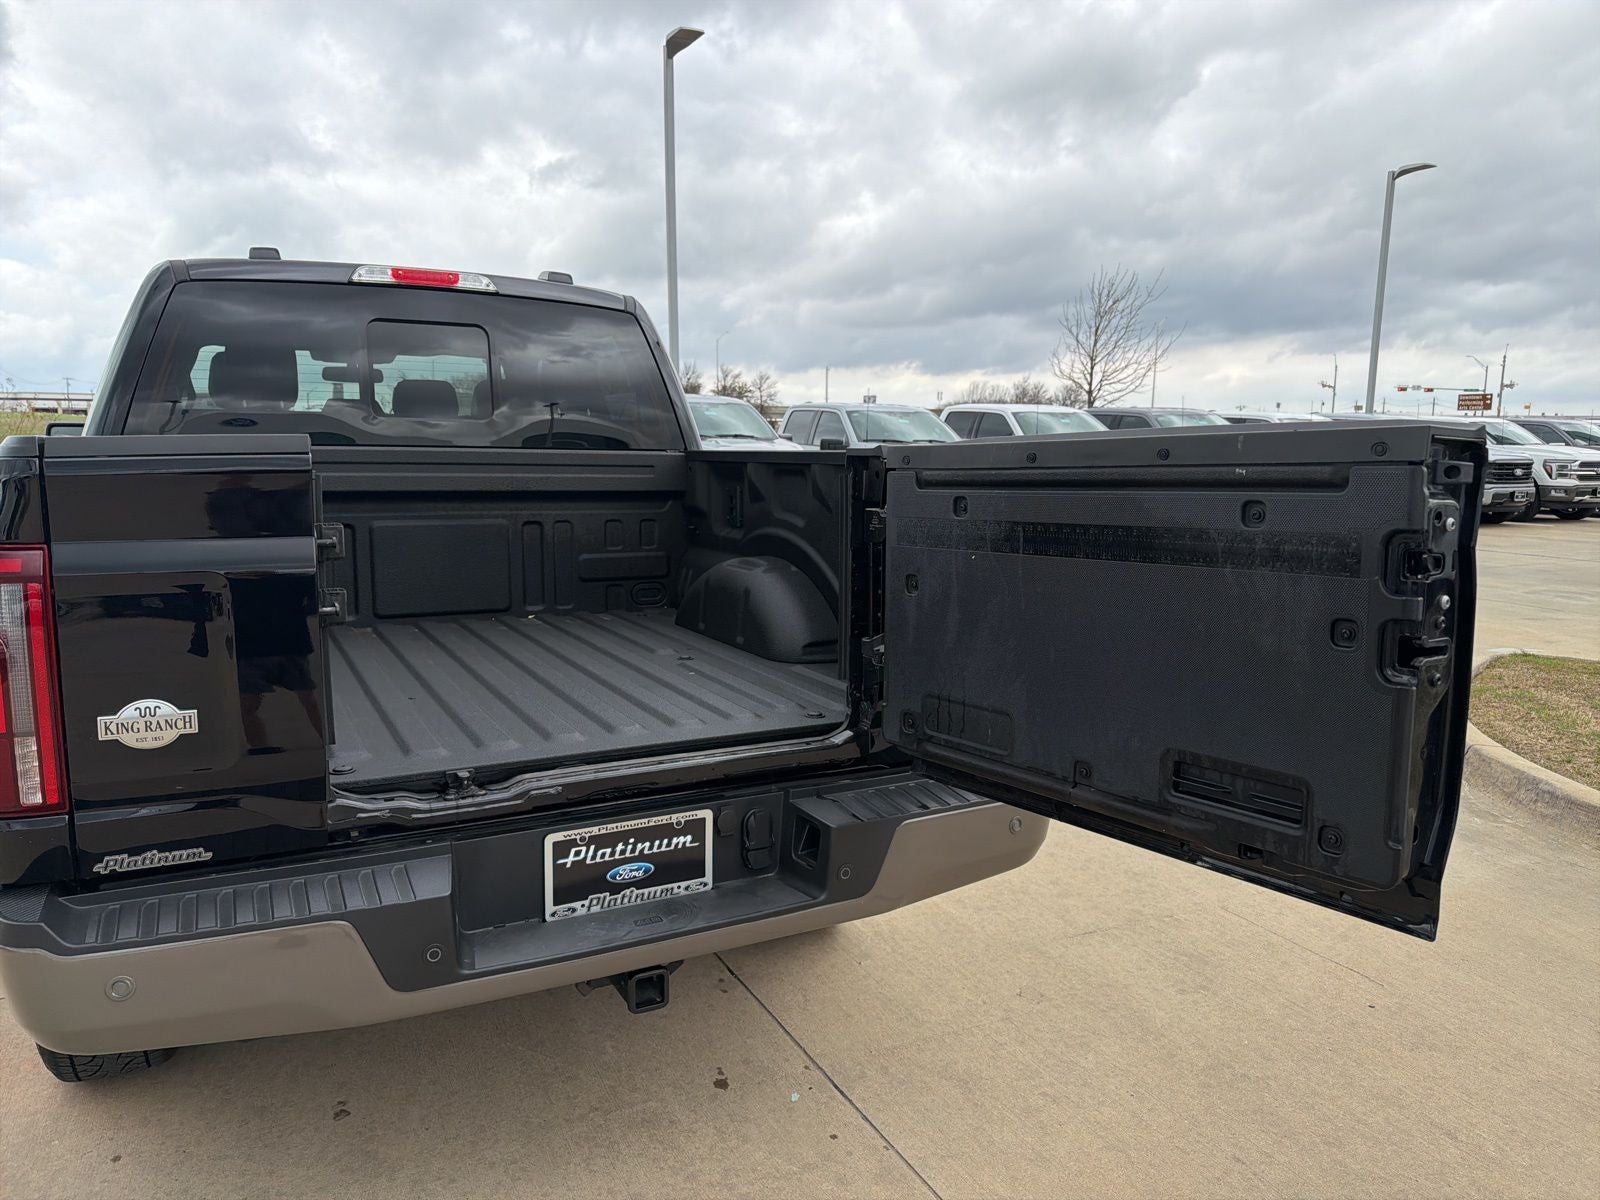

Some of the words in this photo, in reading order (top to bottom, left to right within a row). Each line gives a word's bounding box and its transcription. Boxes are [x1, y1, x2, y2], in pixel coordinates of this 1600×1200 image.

[103, 719, 140, 736] KING
[144, 714, 193, 734] RANCH
[562, 813, 699, 839] www.PlatinumFord.com
[92, 846, 213, 874] Platinum
[556, 834, 700, 869] Platinum
[616, 865, 645, 881] Ford
[586, 887, 681, 912] Platinum
